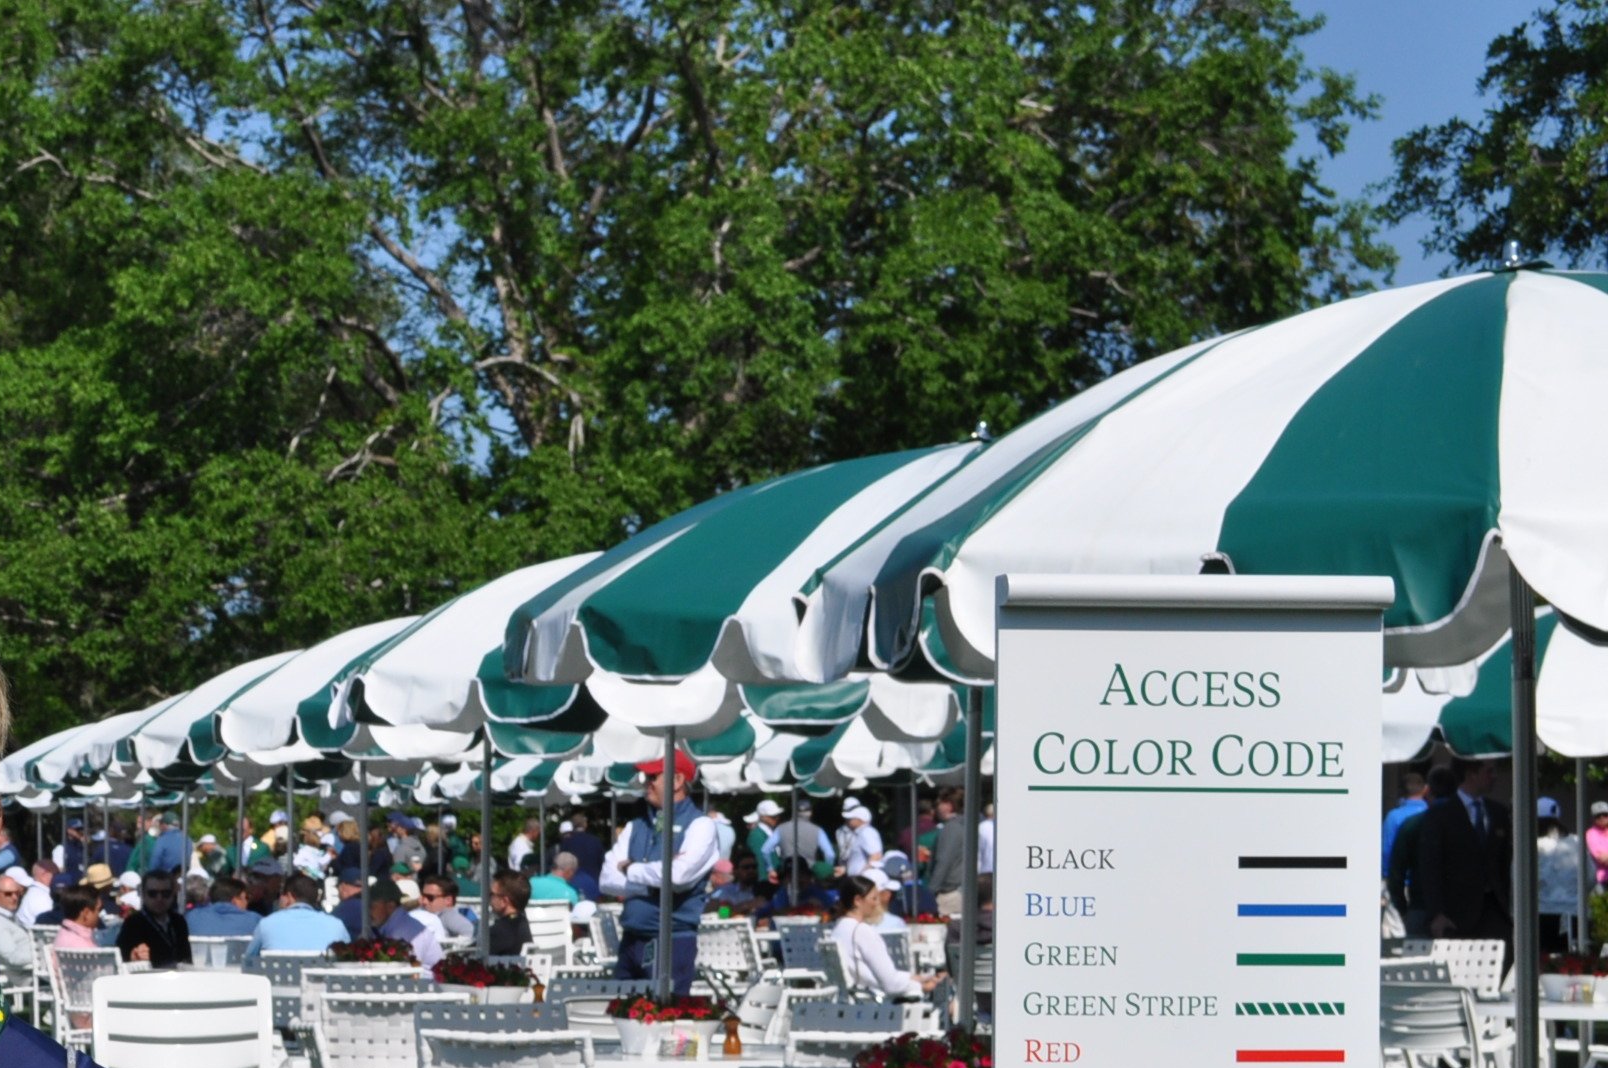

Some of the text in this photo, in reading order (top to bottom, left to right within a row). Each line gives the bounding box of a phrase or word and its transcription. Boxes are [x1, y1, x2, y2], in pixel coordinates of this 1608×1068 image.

[1099, 663, 1282, 707] ACCESS
[1032, 732, 1345, 778] COLOR CODE
[1025, 845, 1116, 871] BLACK
[1024, 893, 1097, 918] BLUE
[1023, 942, 1119, 967] GREEN
[1022, 992, 1219, 1018] GREEN STRIPE
[1024, 1039, 1082, 1064] RED
